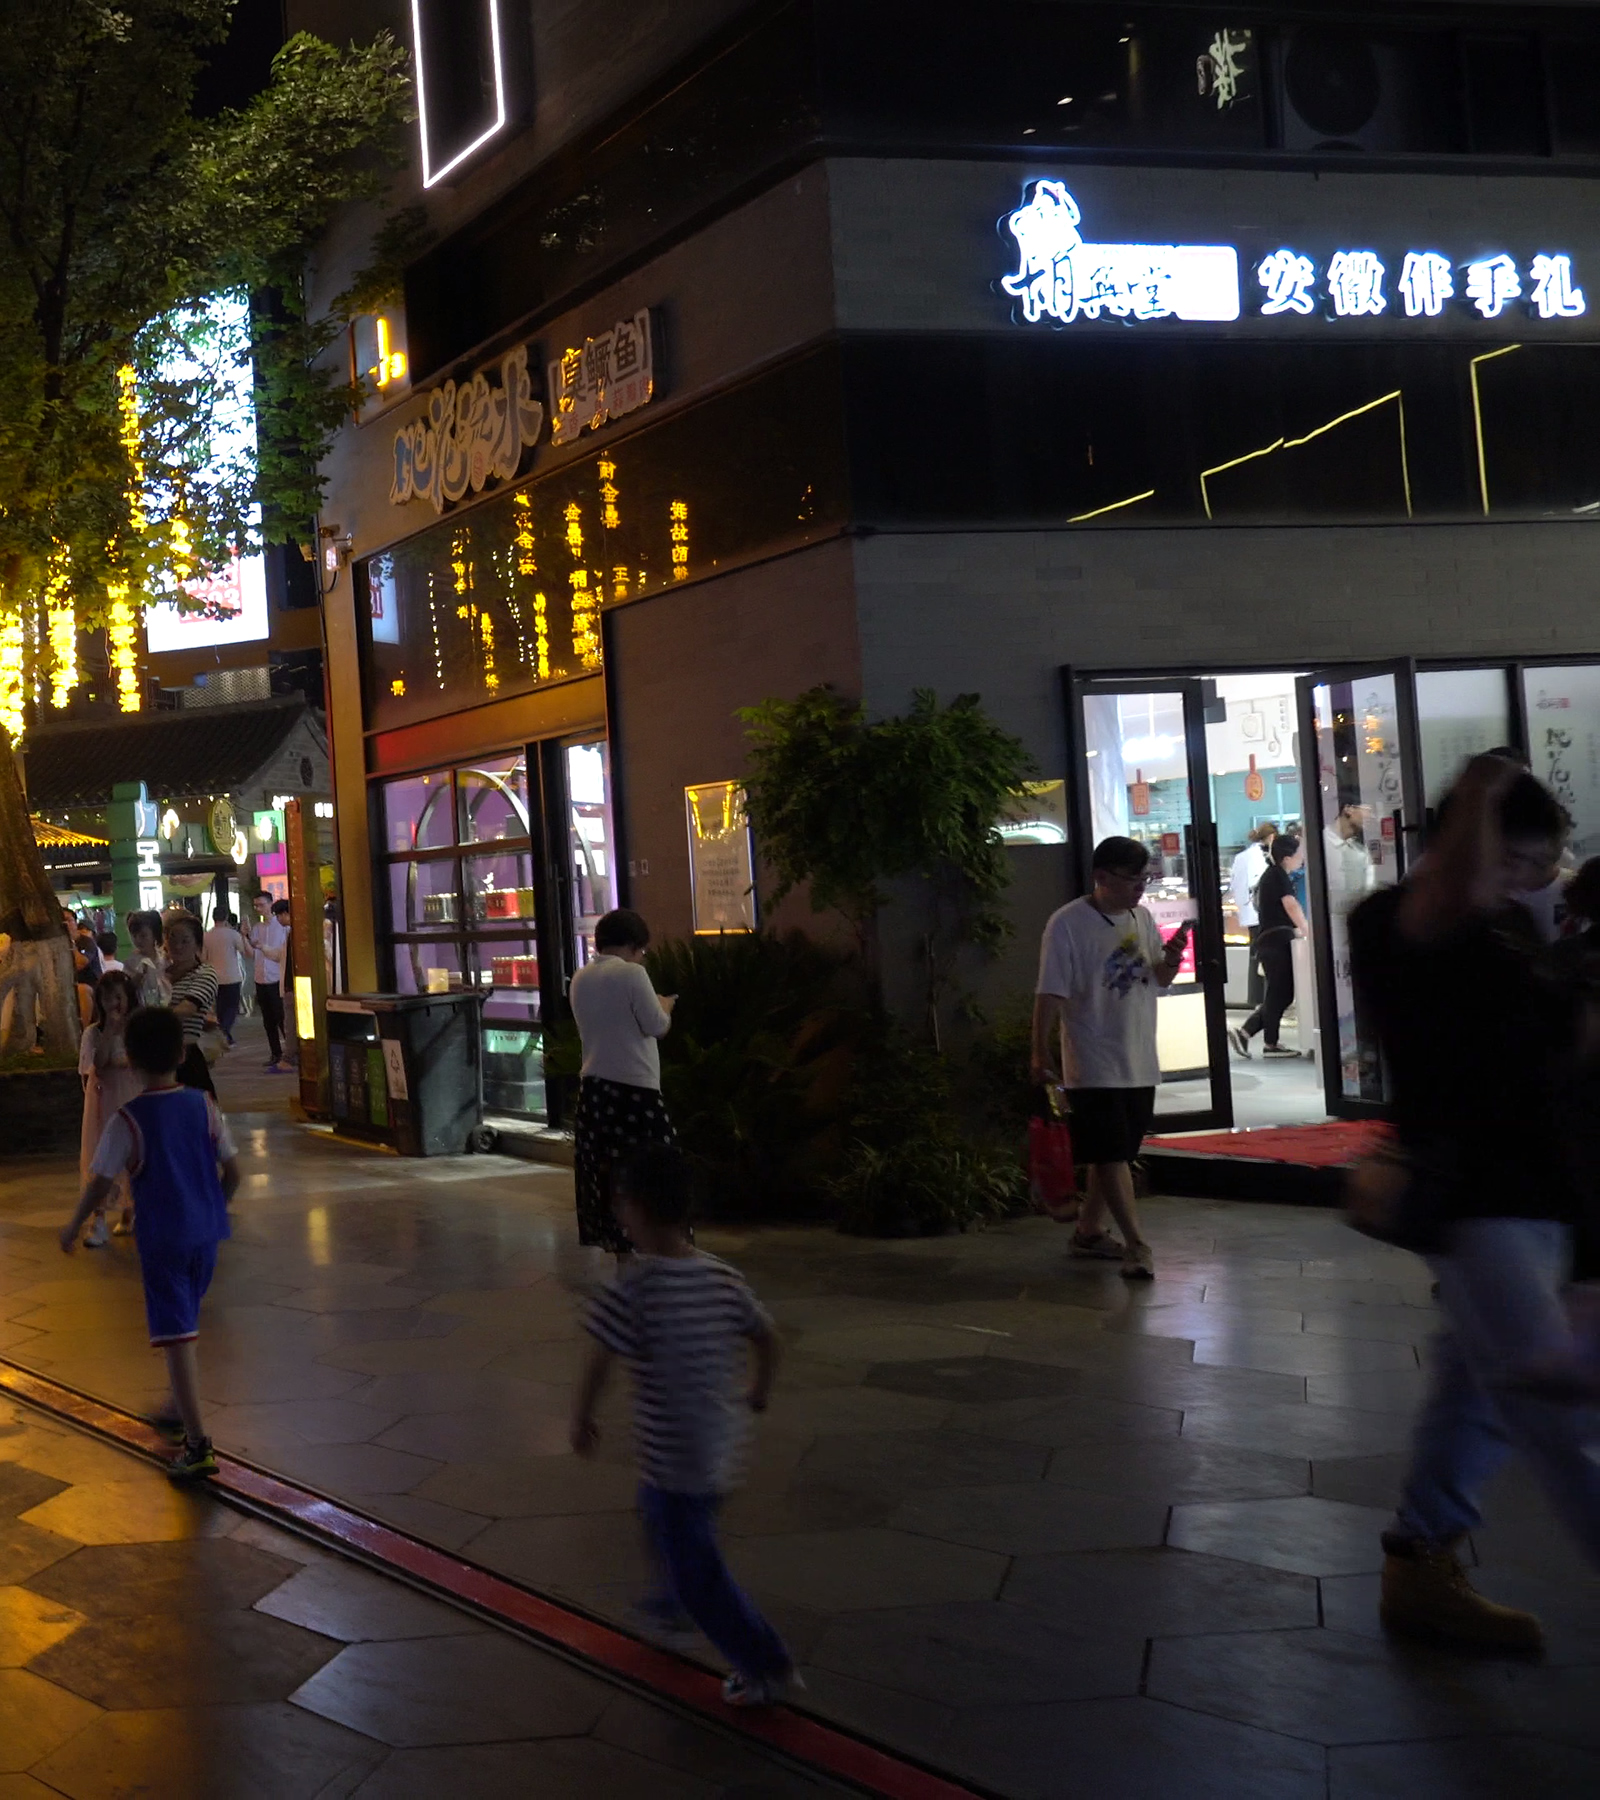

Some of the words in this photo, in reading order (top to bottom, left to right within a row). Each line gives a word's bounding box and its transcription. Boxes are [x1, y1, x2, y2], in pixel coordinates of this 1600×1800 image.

[1258, 249, 1586, 318] 安徽伴手礼
